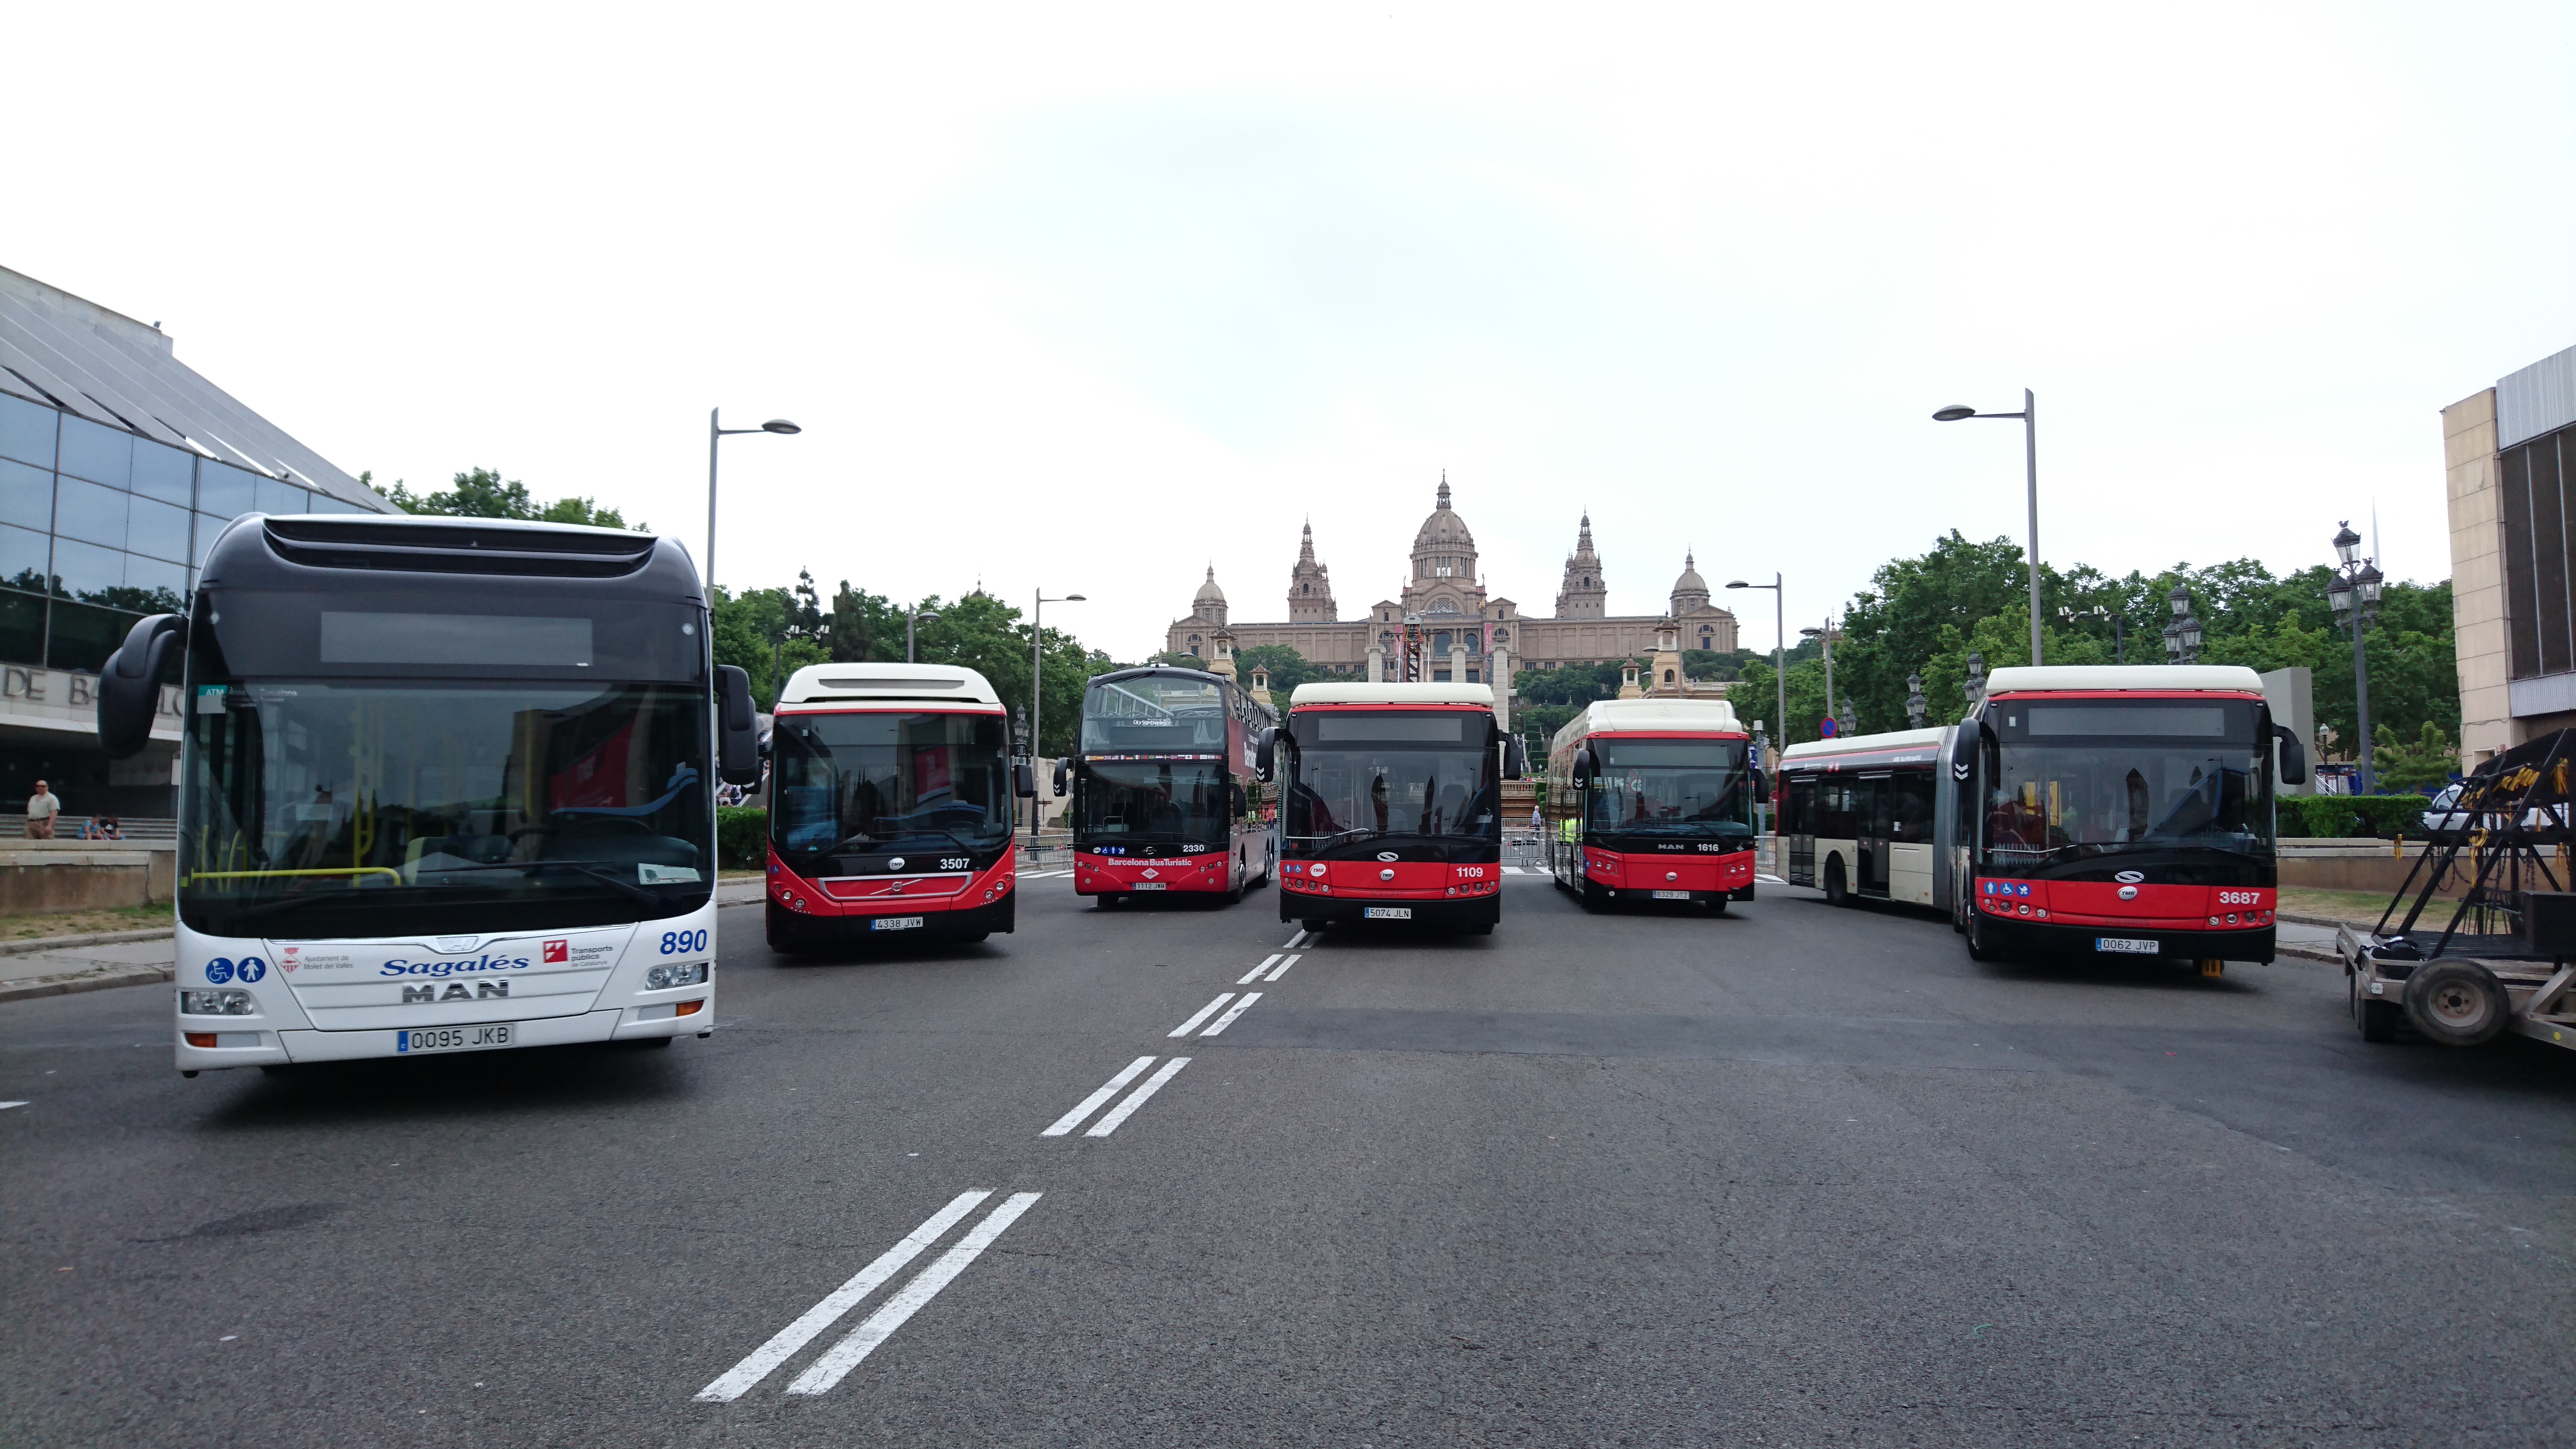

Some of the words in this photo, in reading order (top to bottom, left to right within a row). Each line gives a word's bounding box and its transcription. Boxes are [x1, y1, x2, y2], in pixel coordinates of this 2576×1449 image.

[3, 668, 45, 700] DE
[1244, 741, 1256, 769] Barcelo
[1697, 843, 1719, 851] 1616
[940, 858, 970, 869] 3507
[1456, 867, 1483, 877] 1109
[2220, 892, 2260, 904] 3687
[1370, 909, 1391, 917] 5074
[1394, 910, 1409, 918] JLN
[877, 920, 901, 928] 4338
[904, 918, 921, 927] JVW
[659, 929, 707, 955] 890
[2103, 939, 2131, 950] 0062
[2136, 941, 2156, 951] JVP
[570, 945, 613, 954] Transports
[571, 953, 600, 962] públics
[379, 954, 530, 977] Sagalés
[402, 978, 509, 1003] MAN
[412, 1029, 463, 1049] 0095
[472, 1027, 509, 1045] JKB
